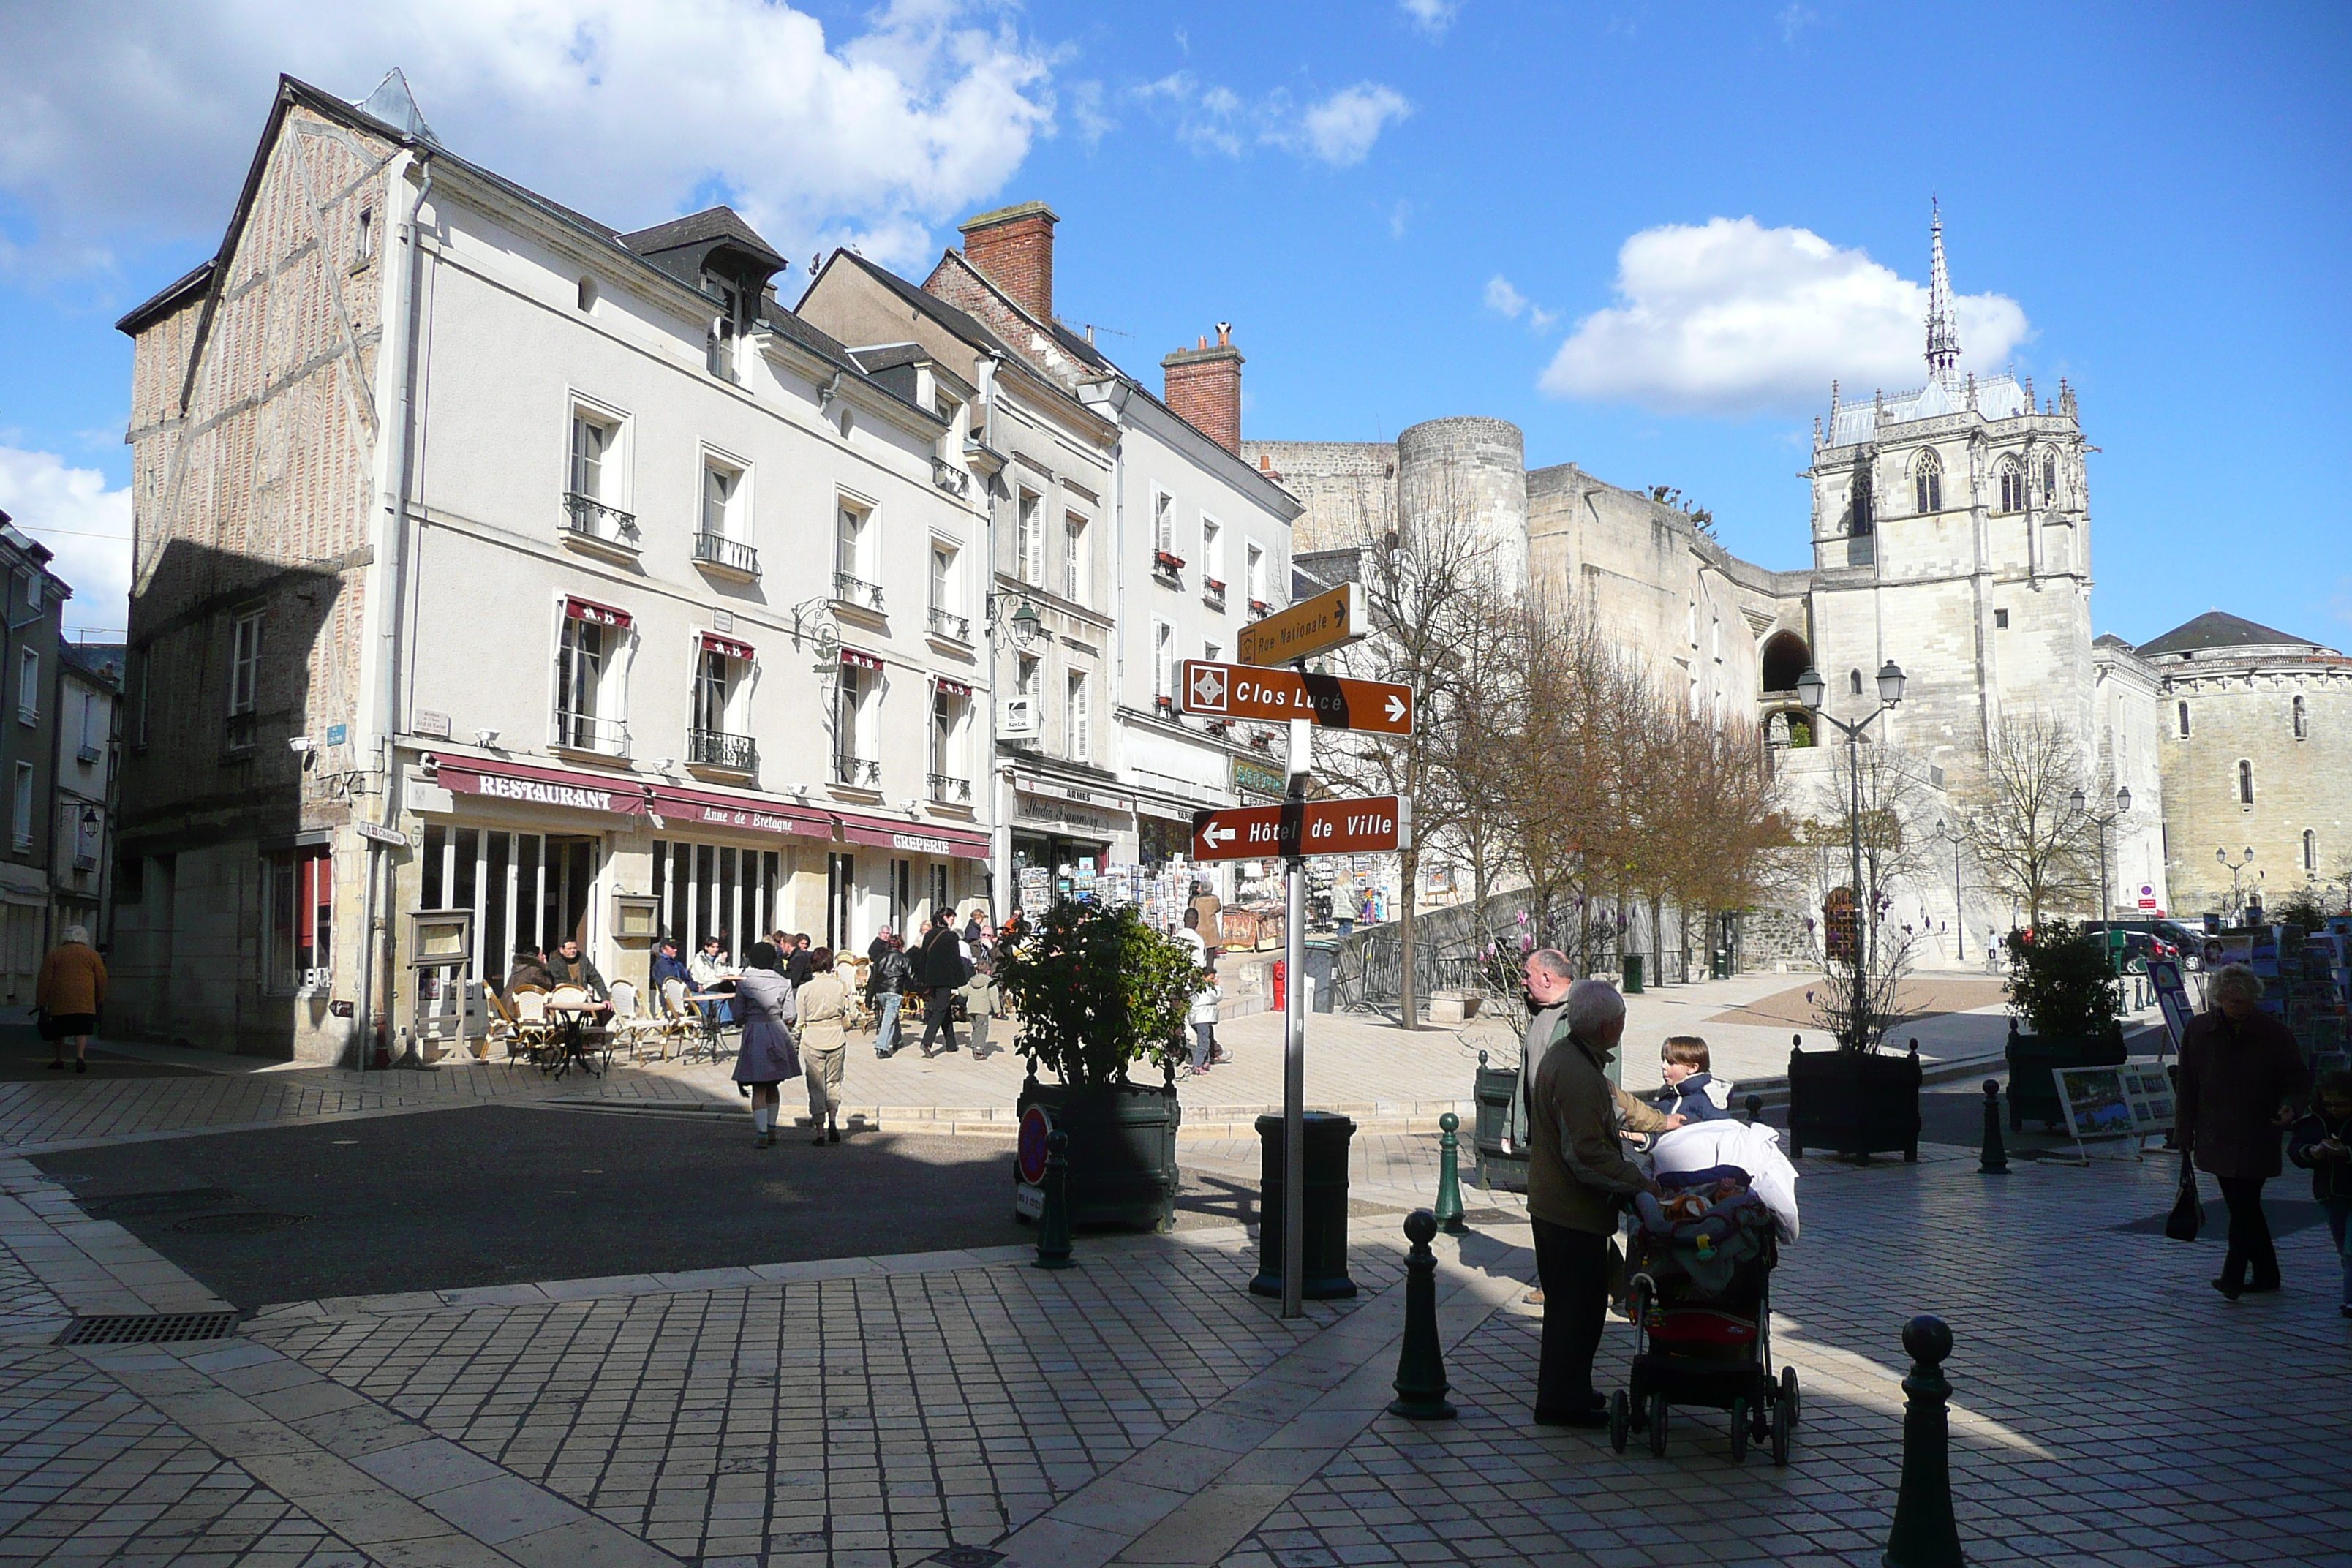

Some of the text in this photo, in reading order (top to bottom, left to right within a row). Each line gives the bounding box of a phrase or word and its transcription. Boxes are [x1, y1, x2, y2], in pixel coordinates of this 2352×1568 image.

[1258, 613, 1327, 653] Rue Nationale
[1237, 682, 1341, 711] Clos Lucé
[479, 775, 611, 810] RESTAURANT
[1066, 789, 1090, 802] ARMES
[703, 806, 793, 832] Anne de Bretagne
[1025, 794, 1052, 818] Studio
[378, 829, 402, 843] Château
[1249, 821, 1296, 842] Hôtel
[1311, 818, 1333, 837] de
[1347, 814, 1392, 835] Ville
[893, 834, 950, 854] CREPERIE
